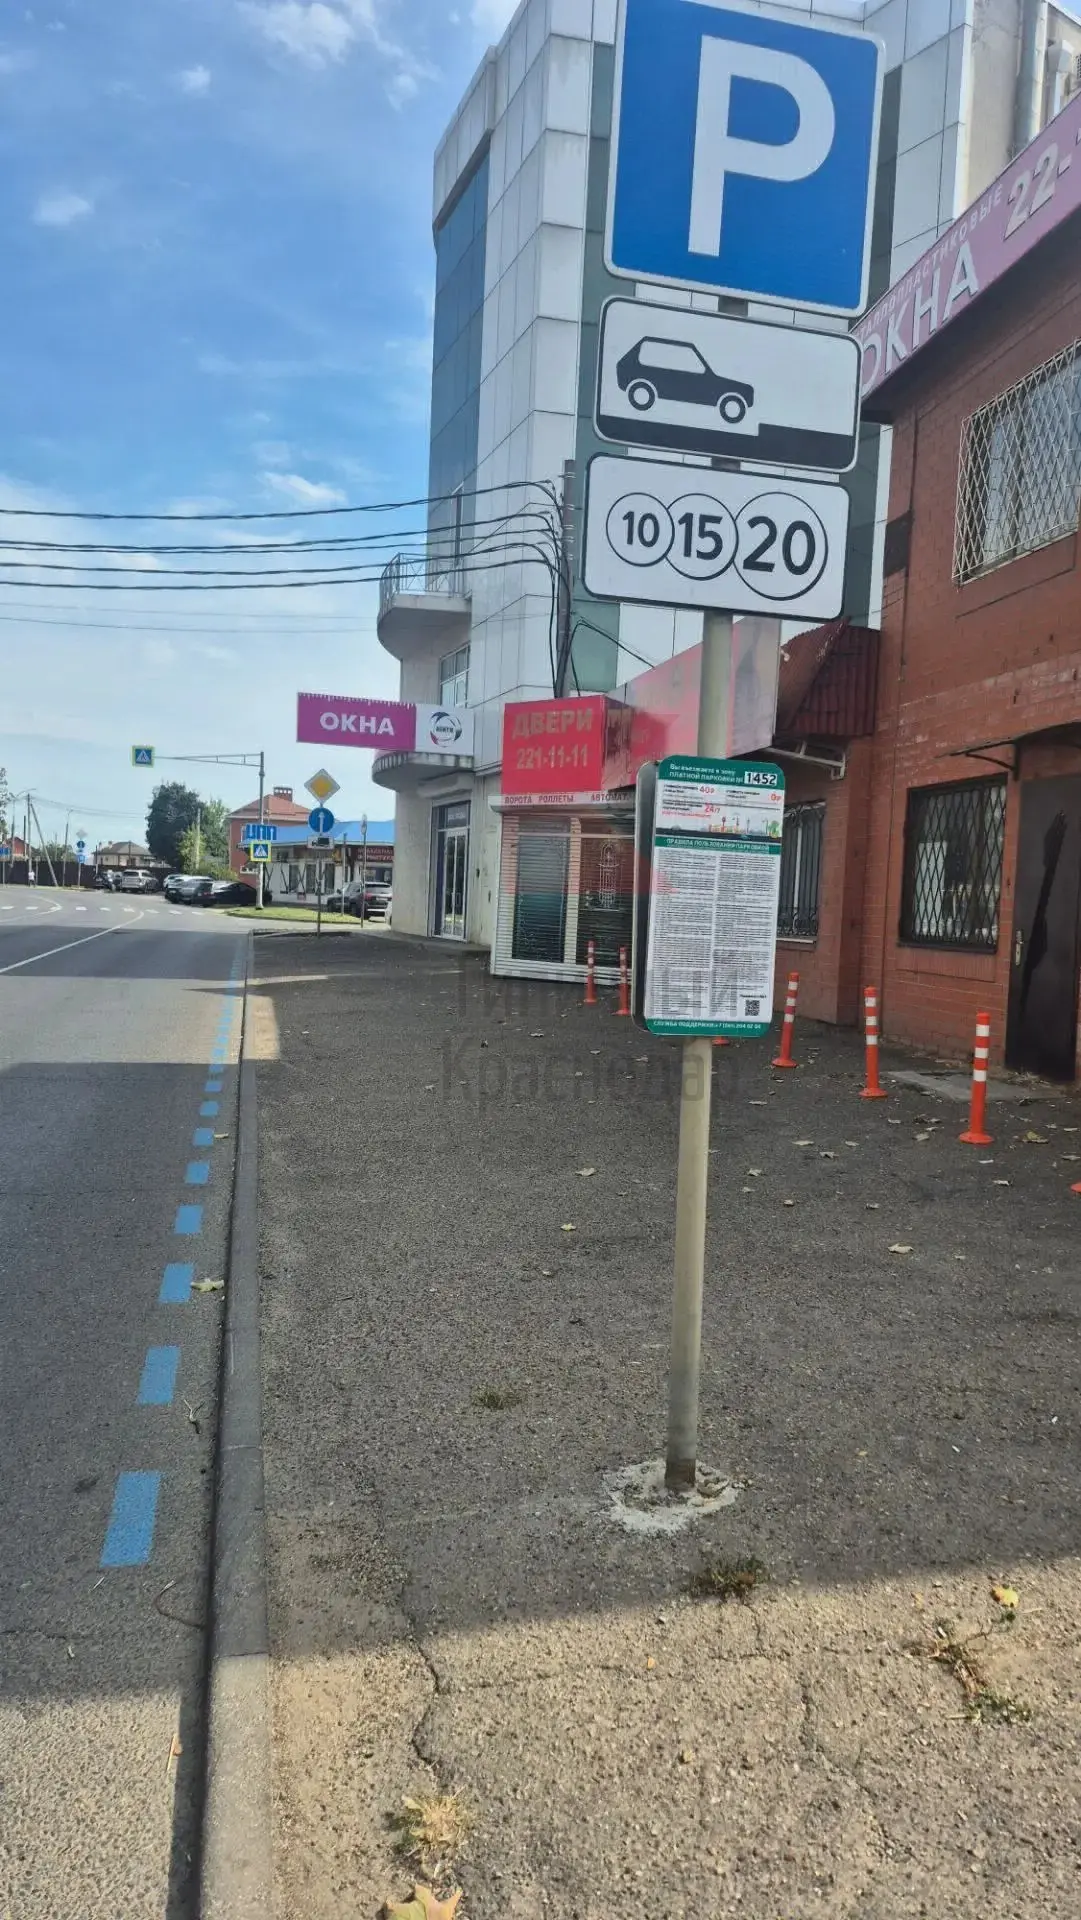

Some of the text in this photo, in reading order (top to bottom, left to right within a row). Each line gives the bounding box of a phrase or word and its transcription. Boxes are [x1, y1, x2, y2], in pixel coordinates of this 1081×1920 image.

[688, 34, 835, 257] P
[622, 511, 816, 576] 10 15 20
[319, 711, 395, 736] ОКНА
[511, 708, 593, 740] ДВЕРИ
[516, 743, 588, 770] 221-11-11
[746, 772, 777, 785] 1452
[504, 796, 532, 805] ВОРОТА
[538, 794, 574, 804] РОЛЛЕТЫ
